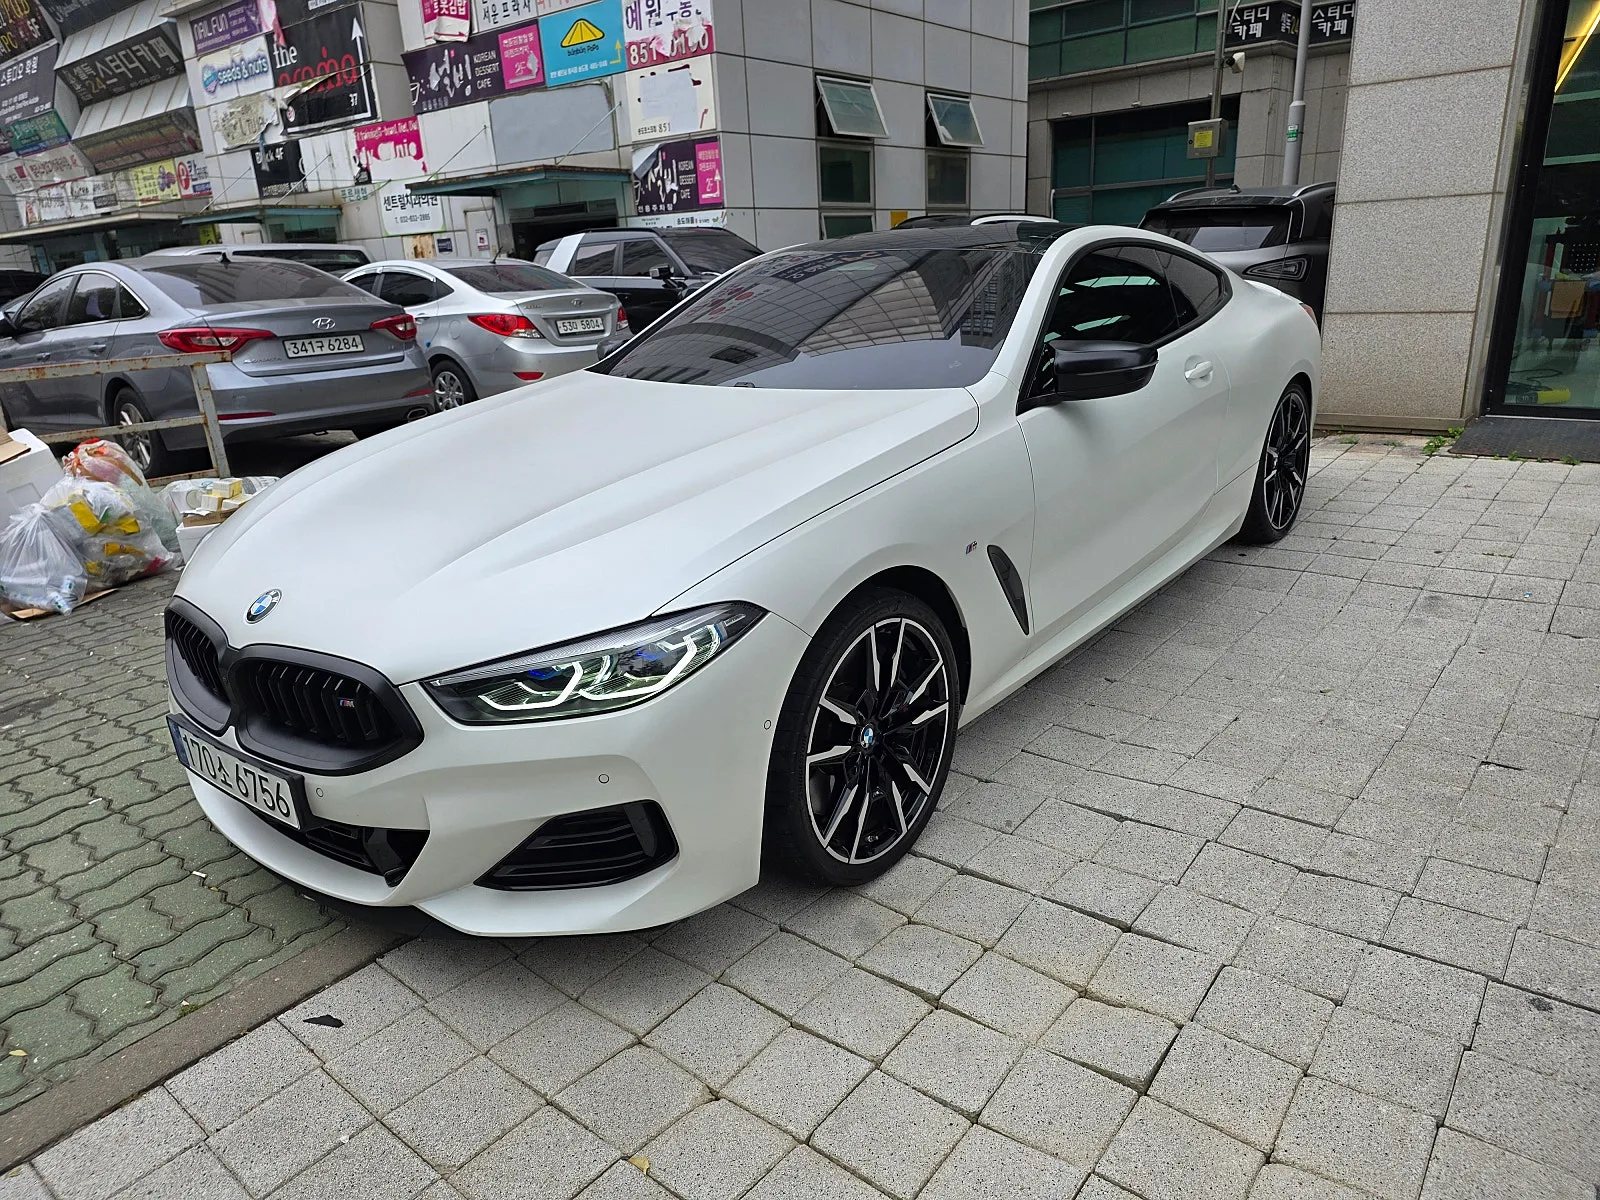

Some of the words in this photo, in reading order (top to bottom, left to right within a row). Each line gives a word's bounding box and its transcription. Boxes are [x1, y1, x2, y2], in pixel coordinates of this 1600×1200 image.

[1312, 3, 1355, 23] 스터디
[1234, 22, 1262, 40] 카페
[1318, 19, 1347, 37] 카페
[95, 36, 179, 85] 스터디카페
[273, 43, 298, 69] the
[472, 50, 497, 64] KOREAN
[217, 62, 242, 85] seeds
[249, 58, 268, 76] nuts
[474, 62, 500, 77] DESSERT
[476, 78, 492, 90] CAFE
[678, 160, 694, 172] KOREAN
[679, 174, 697, 186] DESSERT
[383, 193, 439, 212] 센트럴치과의원
[681, 188, 691, 200] CAFE
[580, 318, 600, 330] 5804
[327, 336, 360, 352] 6284
[182, 733, 234, 790] 170소
[235, 763, 291, 819] 6756
